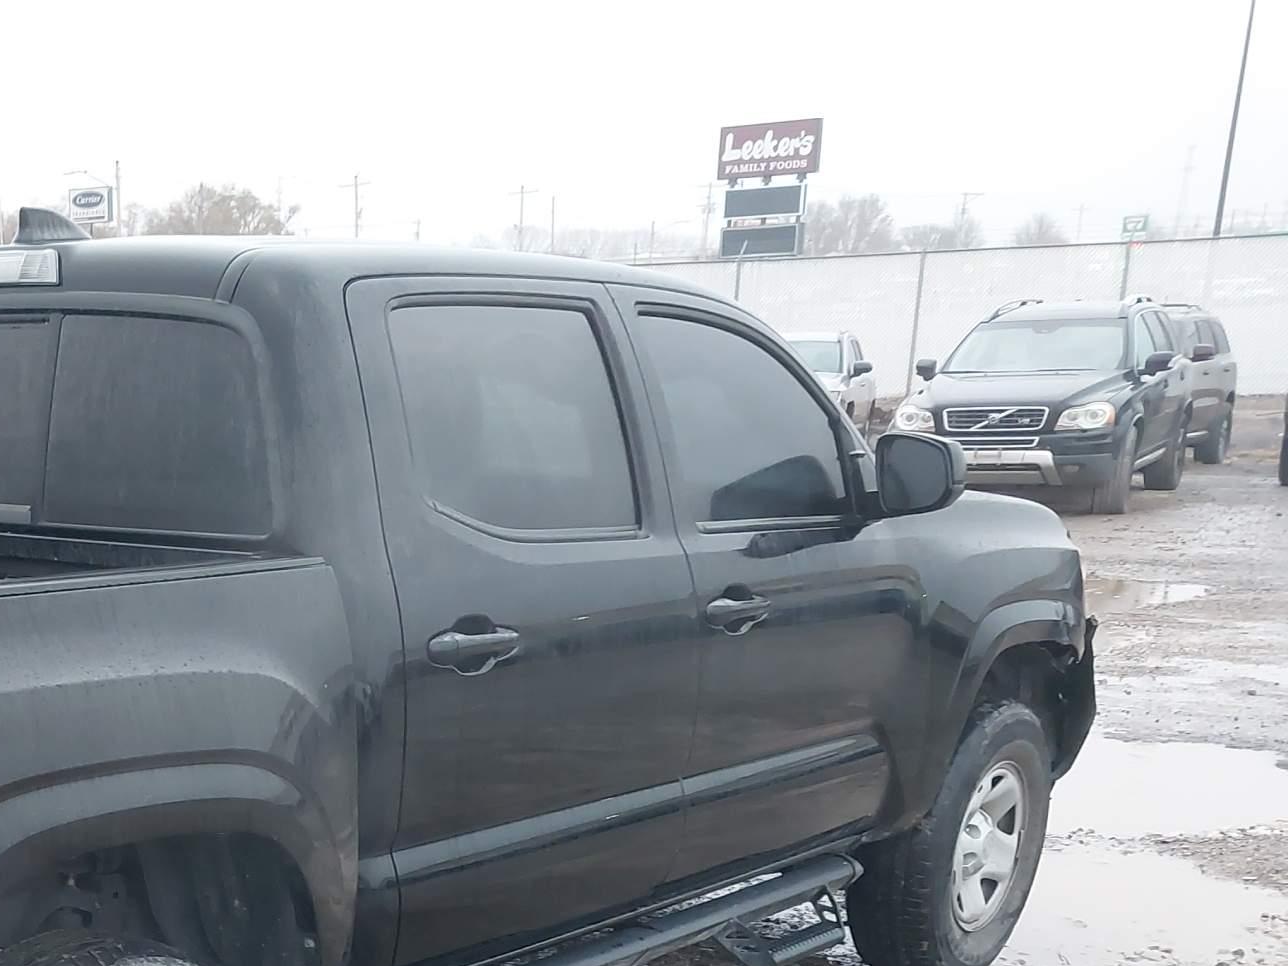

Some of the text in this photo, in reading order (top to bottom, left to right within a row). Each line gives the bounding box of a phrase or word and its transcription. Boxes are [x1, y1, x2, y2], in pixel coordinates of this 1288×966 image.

[722, 130, 815, 161] Leeker's
[725, 159, 808, 174] FAMILY FOODS
[75, 194, 103, 204] Carrier
